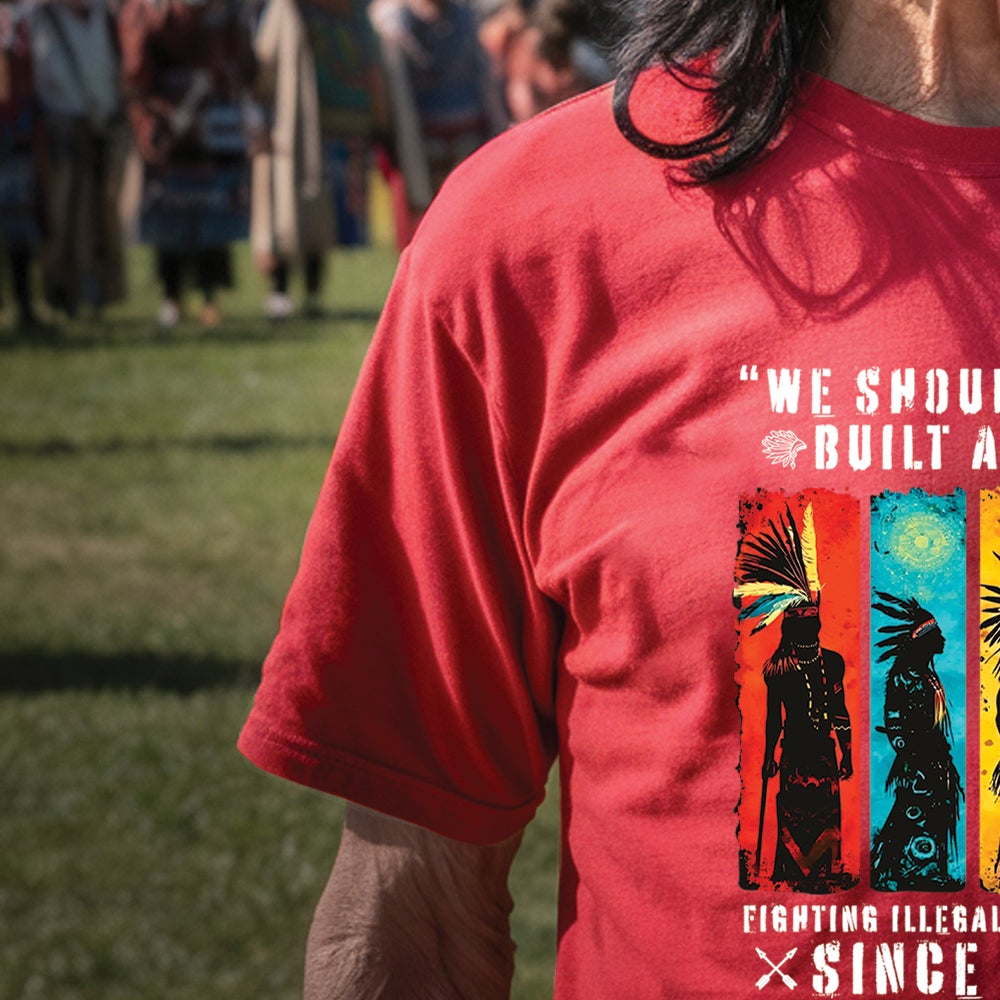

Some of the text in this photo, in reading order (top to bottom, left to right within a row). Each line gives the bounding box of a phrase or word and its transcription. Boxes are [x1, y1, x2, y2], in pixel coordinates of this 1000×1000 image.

[739, 365, 837, 417] “WE
[815, 424, 950, 471] BUILT
[972, 425, 998, 471] A
[743, 904, 878, 934] FIGHTING
[812, 940, 983, 999] SINCE
